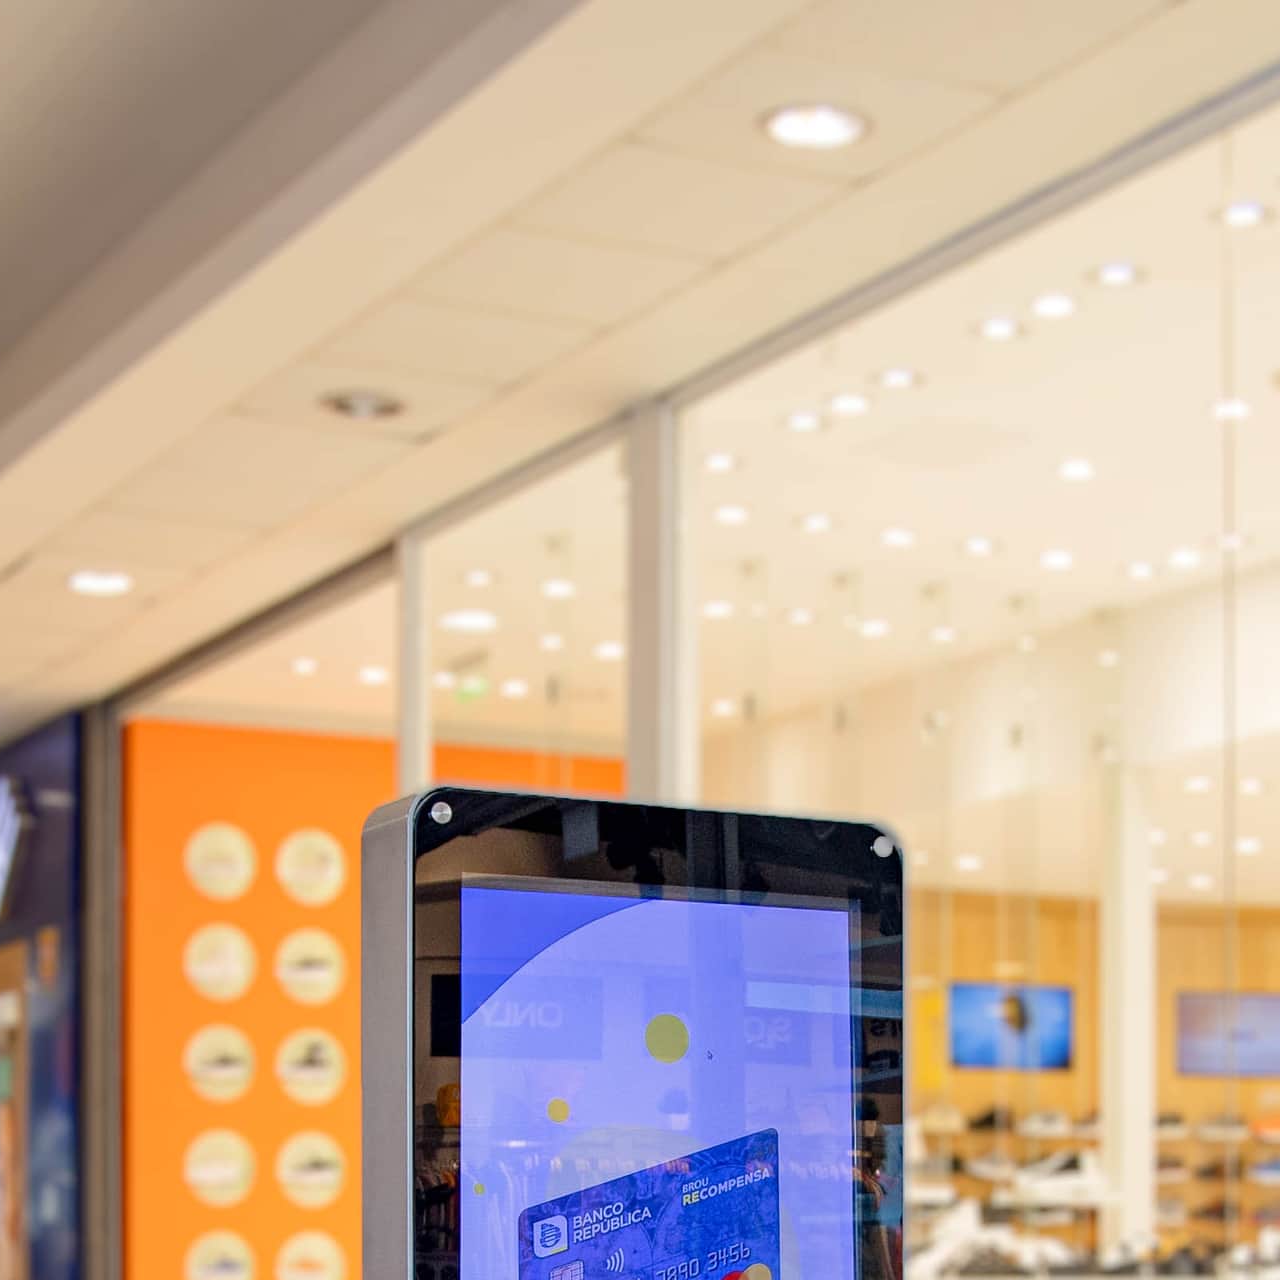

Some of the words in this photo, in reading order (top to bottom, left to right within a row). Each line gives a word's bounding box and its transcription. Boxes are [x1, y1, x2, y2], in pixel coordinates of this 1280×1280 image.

[682, 1176, 709, 1193] BROU
[682, 1167, 771, 1207] RECOMPENSA
[573, 1202, 624, 1230] BANCO
[573, 1207, 652, 1244] REPÚBLICA
[707, 1242, 751, 1272] 3456
